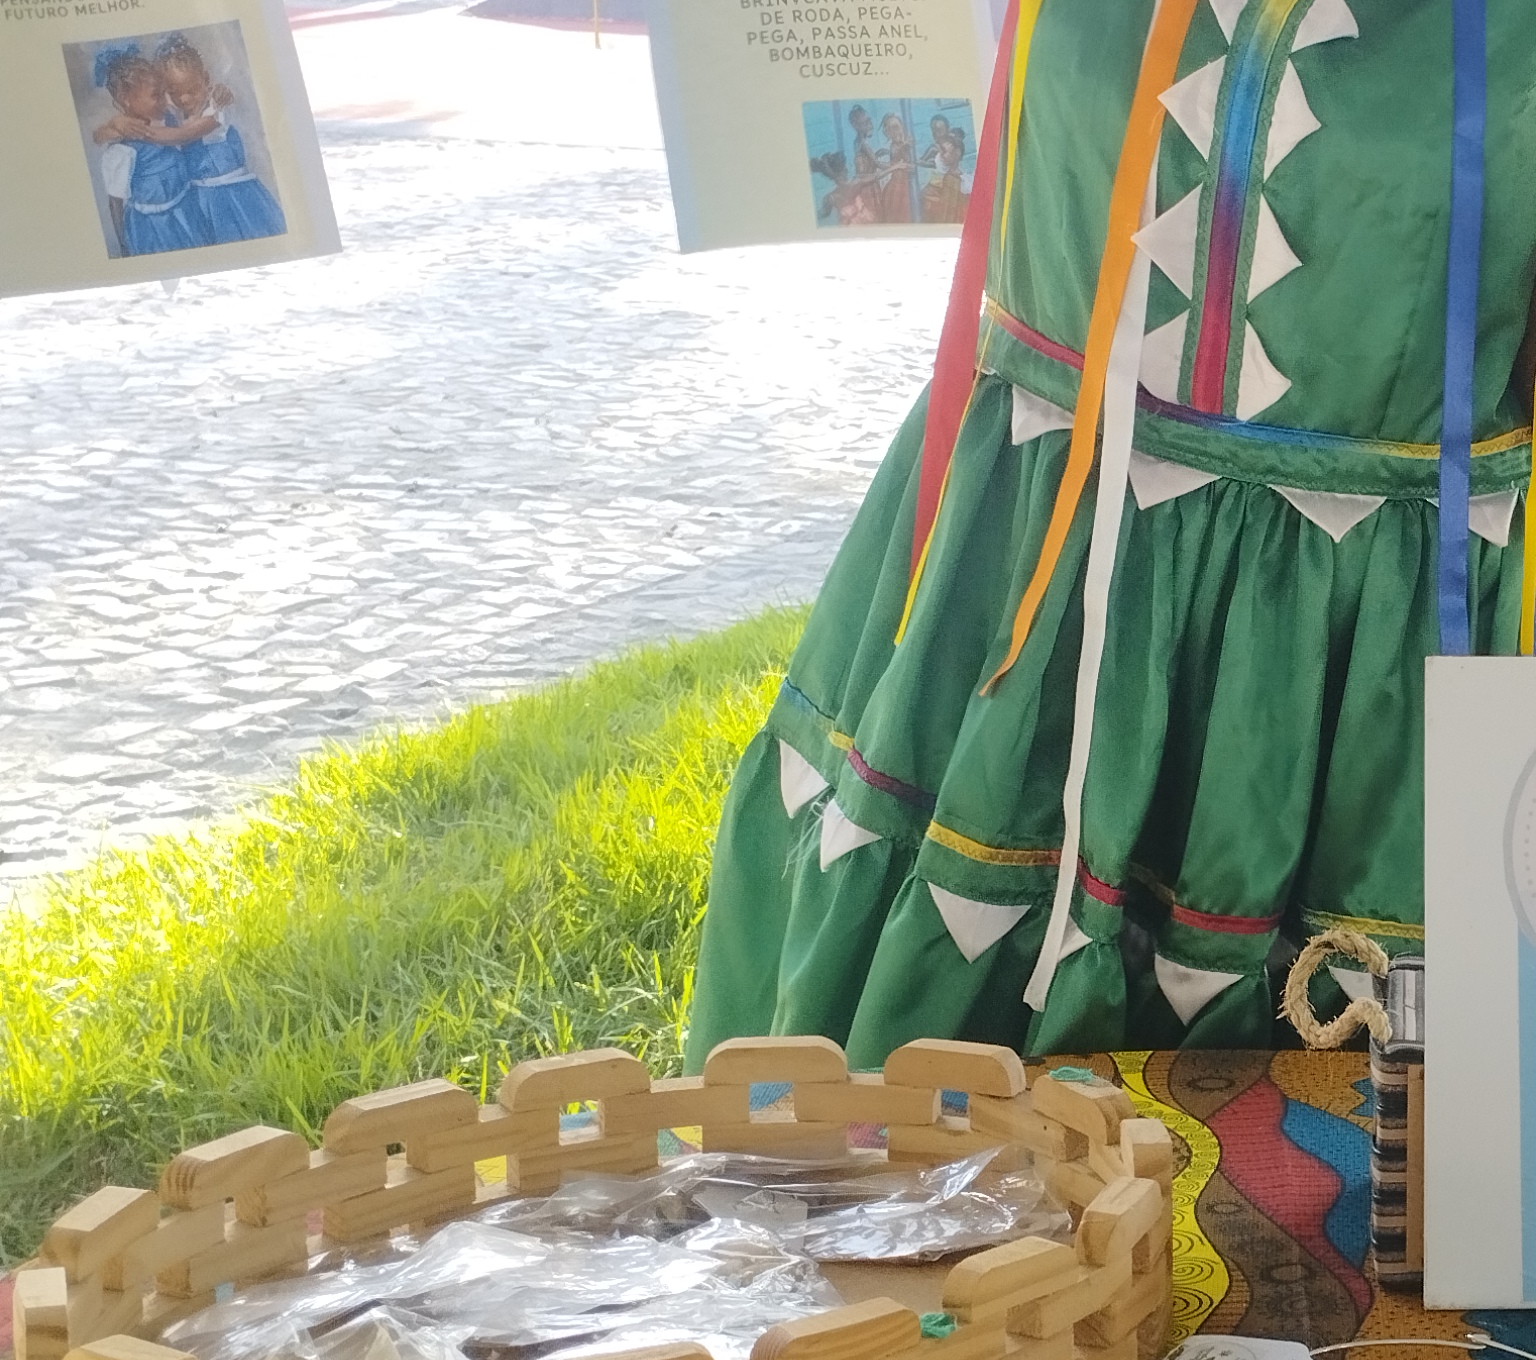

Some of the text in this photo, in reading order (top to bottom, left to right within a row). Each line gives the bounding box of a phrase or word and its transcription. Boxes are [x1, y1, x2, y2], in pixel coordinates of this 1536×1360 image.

[4, 5, 69, 21] FUTURO
[761, 6, 912, 26] DE RODA, PEGA-
[746, 24, 929, 46] PEGA, PASSA ANEL,
[769, 42, 913, 63] BOMBAQUEIRO,
[799, 61, 890, 79] CUSCUZ...
